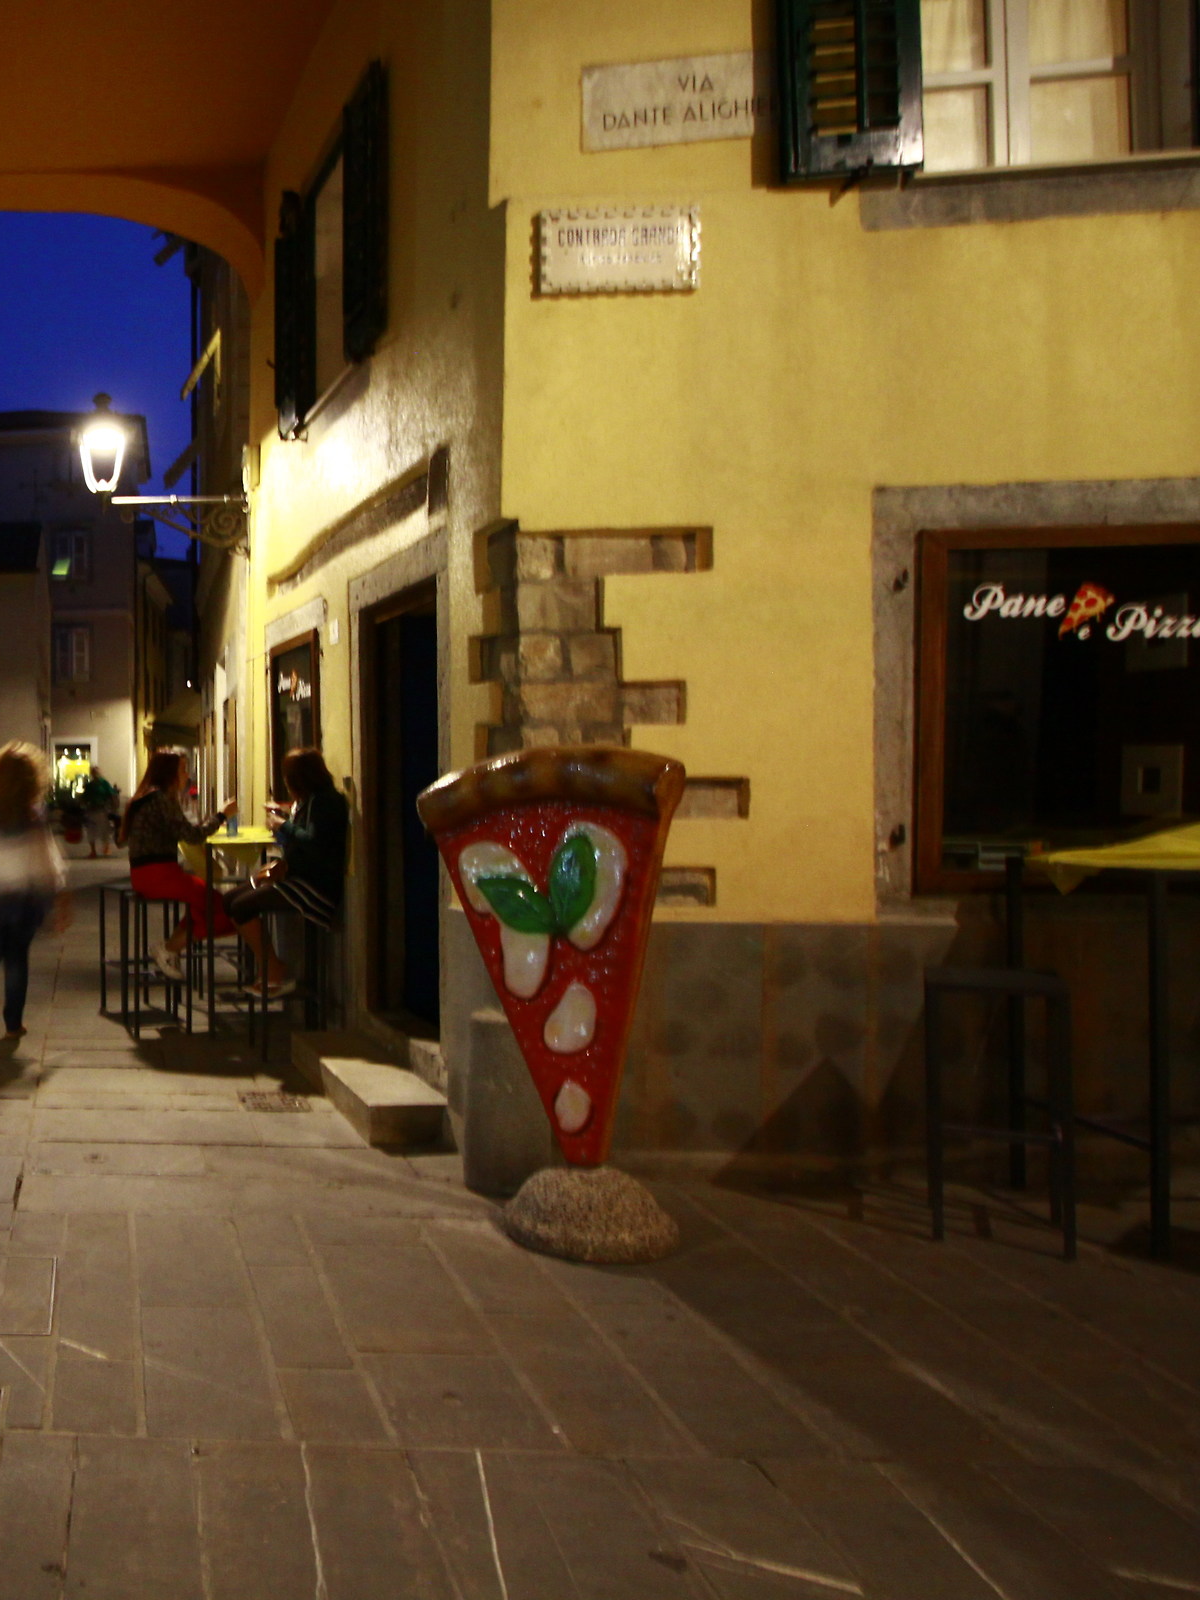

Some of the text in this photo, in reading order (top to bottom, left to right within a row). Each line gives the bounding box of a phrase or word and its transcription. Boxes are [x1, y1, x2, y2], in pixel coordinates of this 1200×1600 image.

[677, 72, 714, 93] VIA
[602, 105, 672, 132] DANTE
[557, 227, 626, 248] CONTRADA
[963, 582, 1066, 621] Pane
[1077, 624, 1091, 641] e
